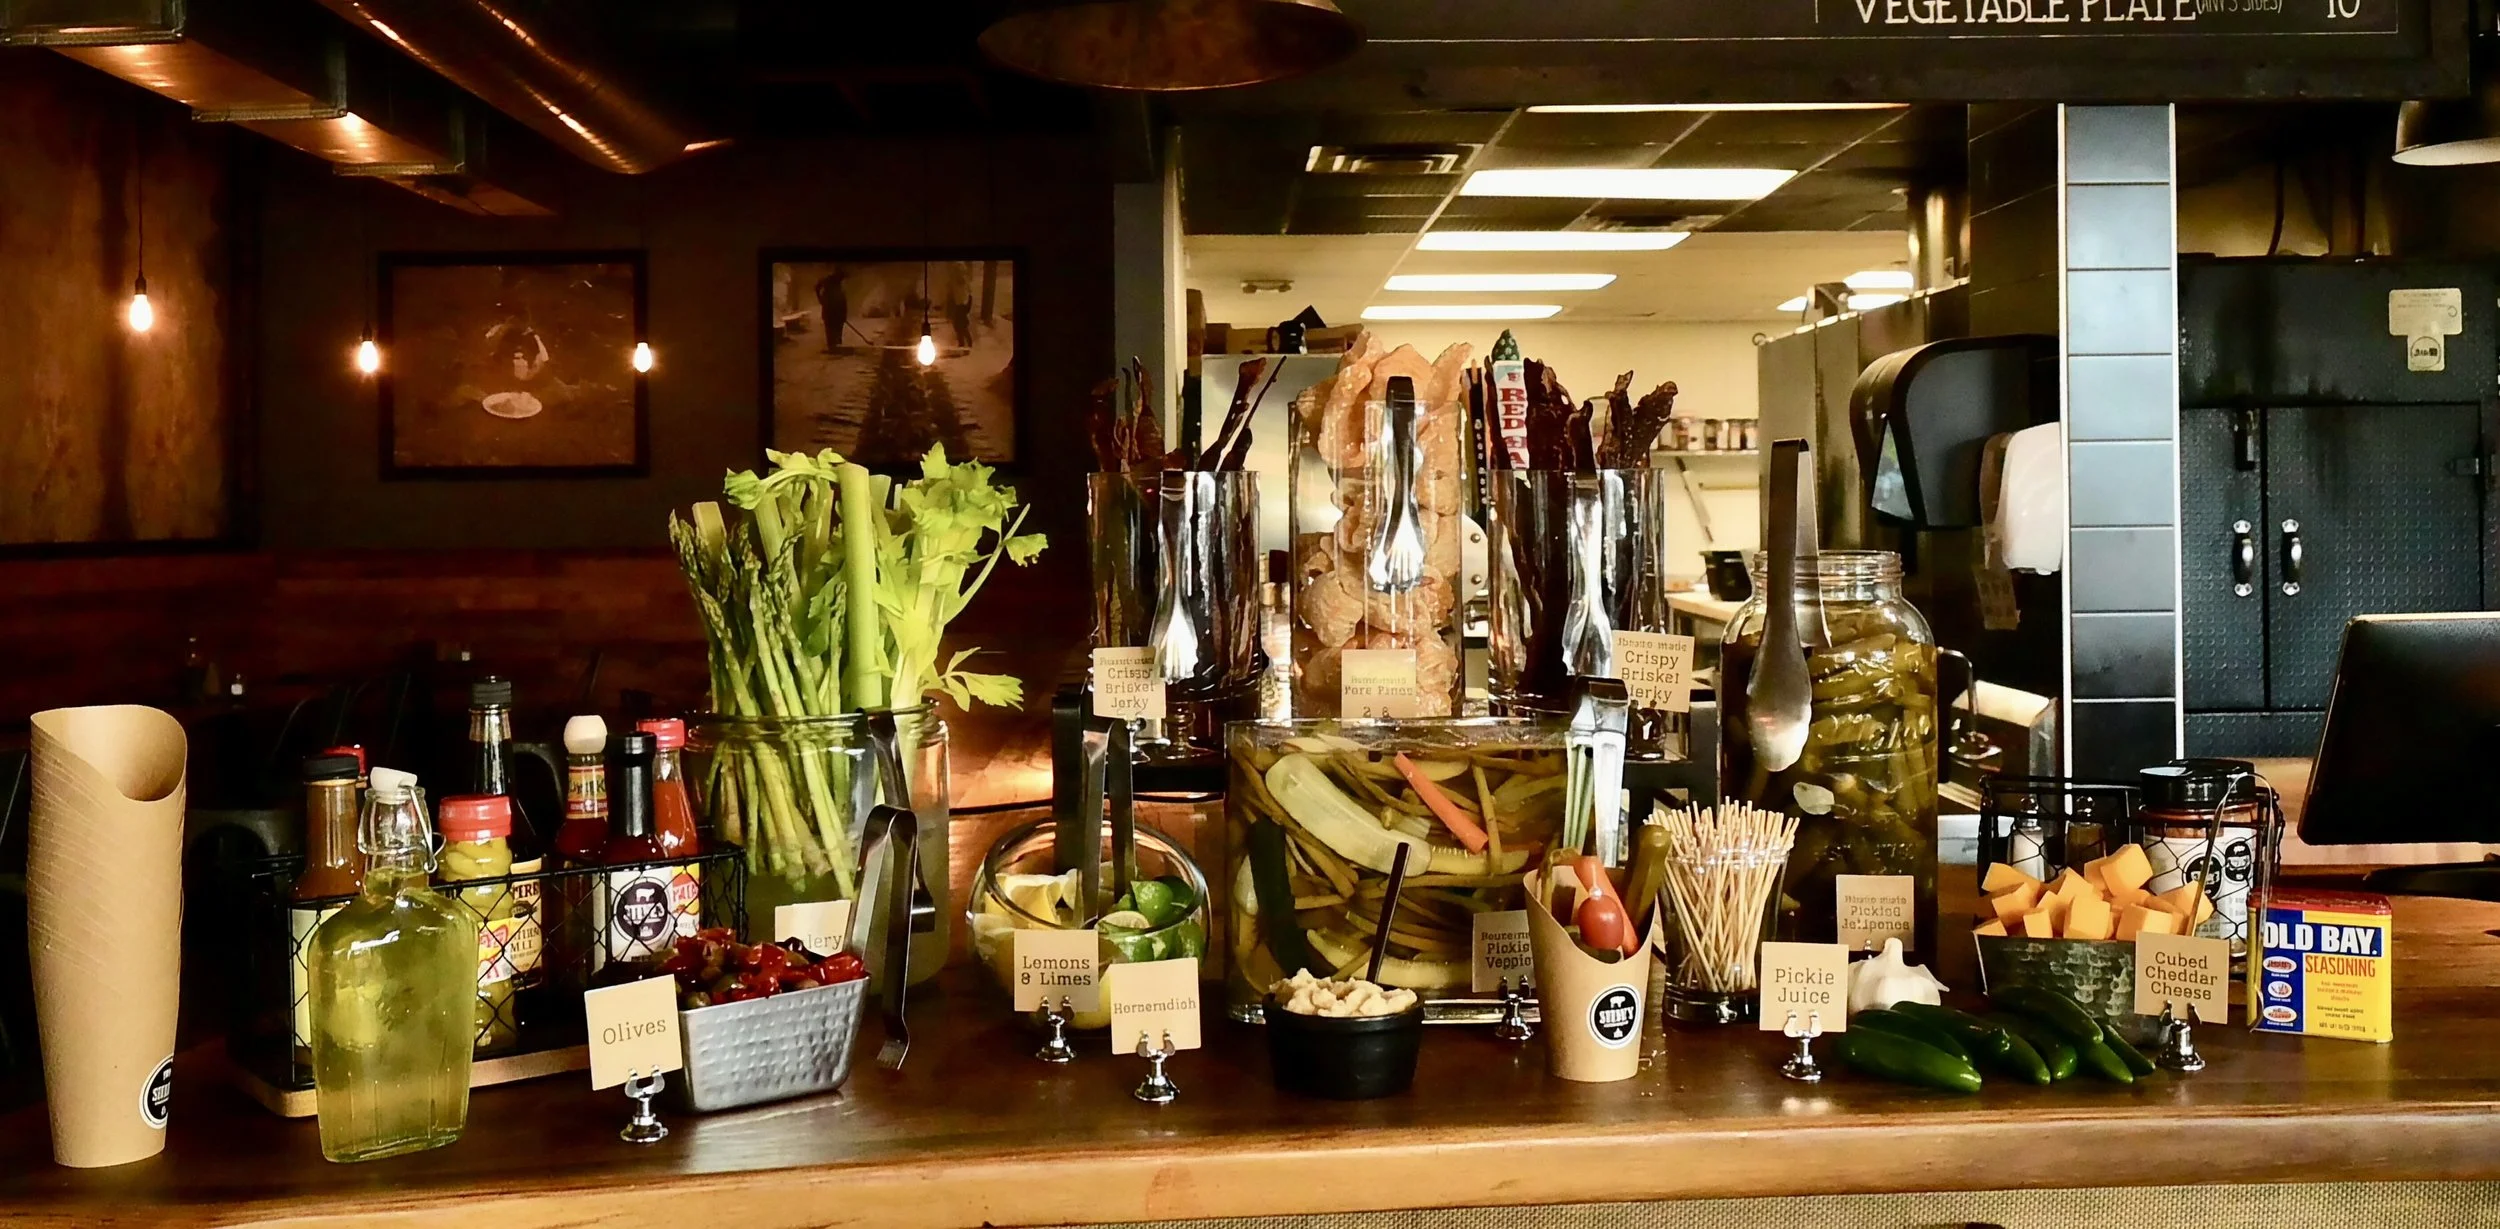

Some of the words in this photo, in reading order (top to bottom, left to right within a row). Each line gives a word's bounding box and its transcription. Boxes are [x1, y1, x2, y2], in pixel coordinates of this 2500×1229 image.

[1855, 0, 2070, 23] VEGETABLE
[2080, 0, 2196, 22] PLATE
[2327, 0, 2360, 18] 10
[1501, 388, 1527, 430] RED
[1625, 650, 1679, 669] Crispy
[1621, 667, 1680, 684] Brisket
[1111, 696, 1148, 710] Jerky
[807, 934, 842, 950] lery
[2263, 921, 2314, 951] OLD
[1023, 956, 1090, 970] Lemons
[1485, 954, 1532, 969] Veggie
[2155, 951, 2208, 969] Cubed
[2305, 954, 2376, 978] SEASONING
[1040, 972, 1091, 986] Limes
[2145, 965, 2218, 986] Cheddar
[1778, 987, 1830, 1004] Juice
[2151, 981, 2212, 1000] Cheese
[603, 1019, 666, 1045] Olives
